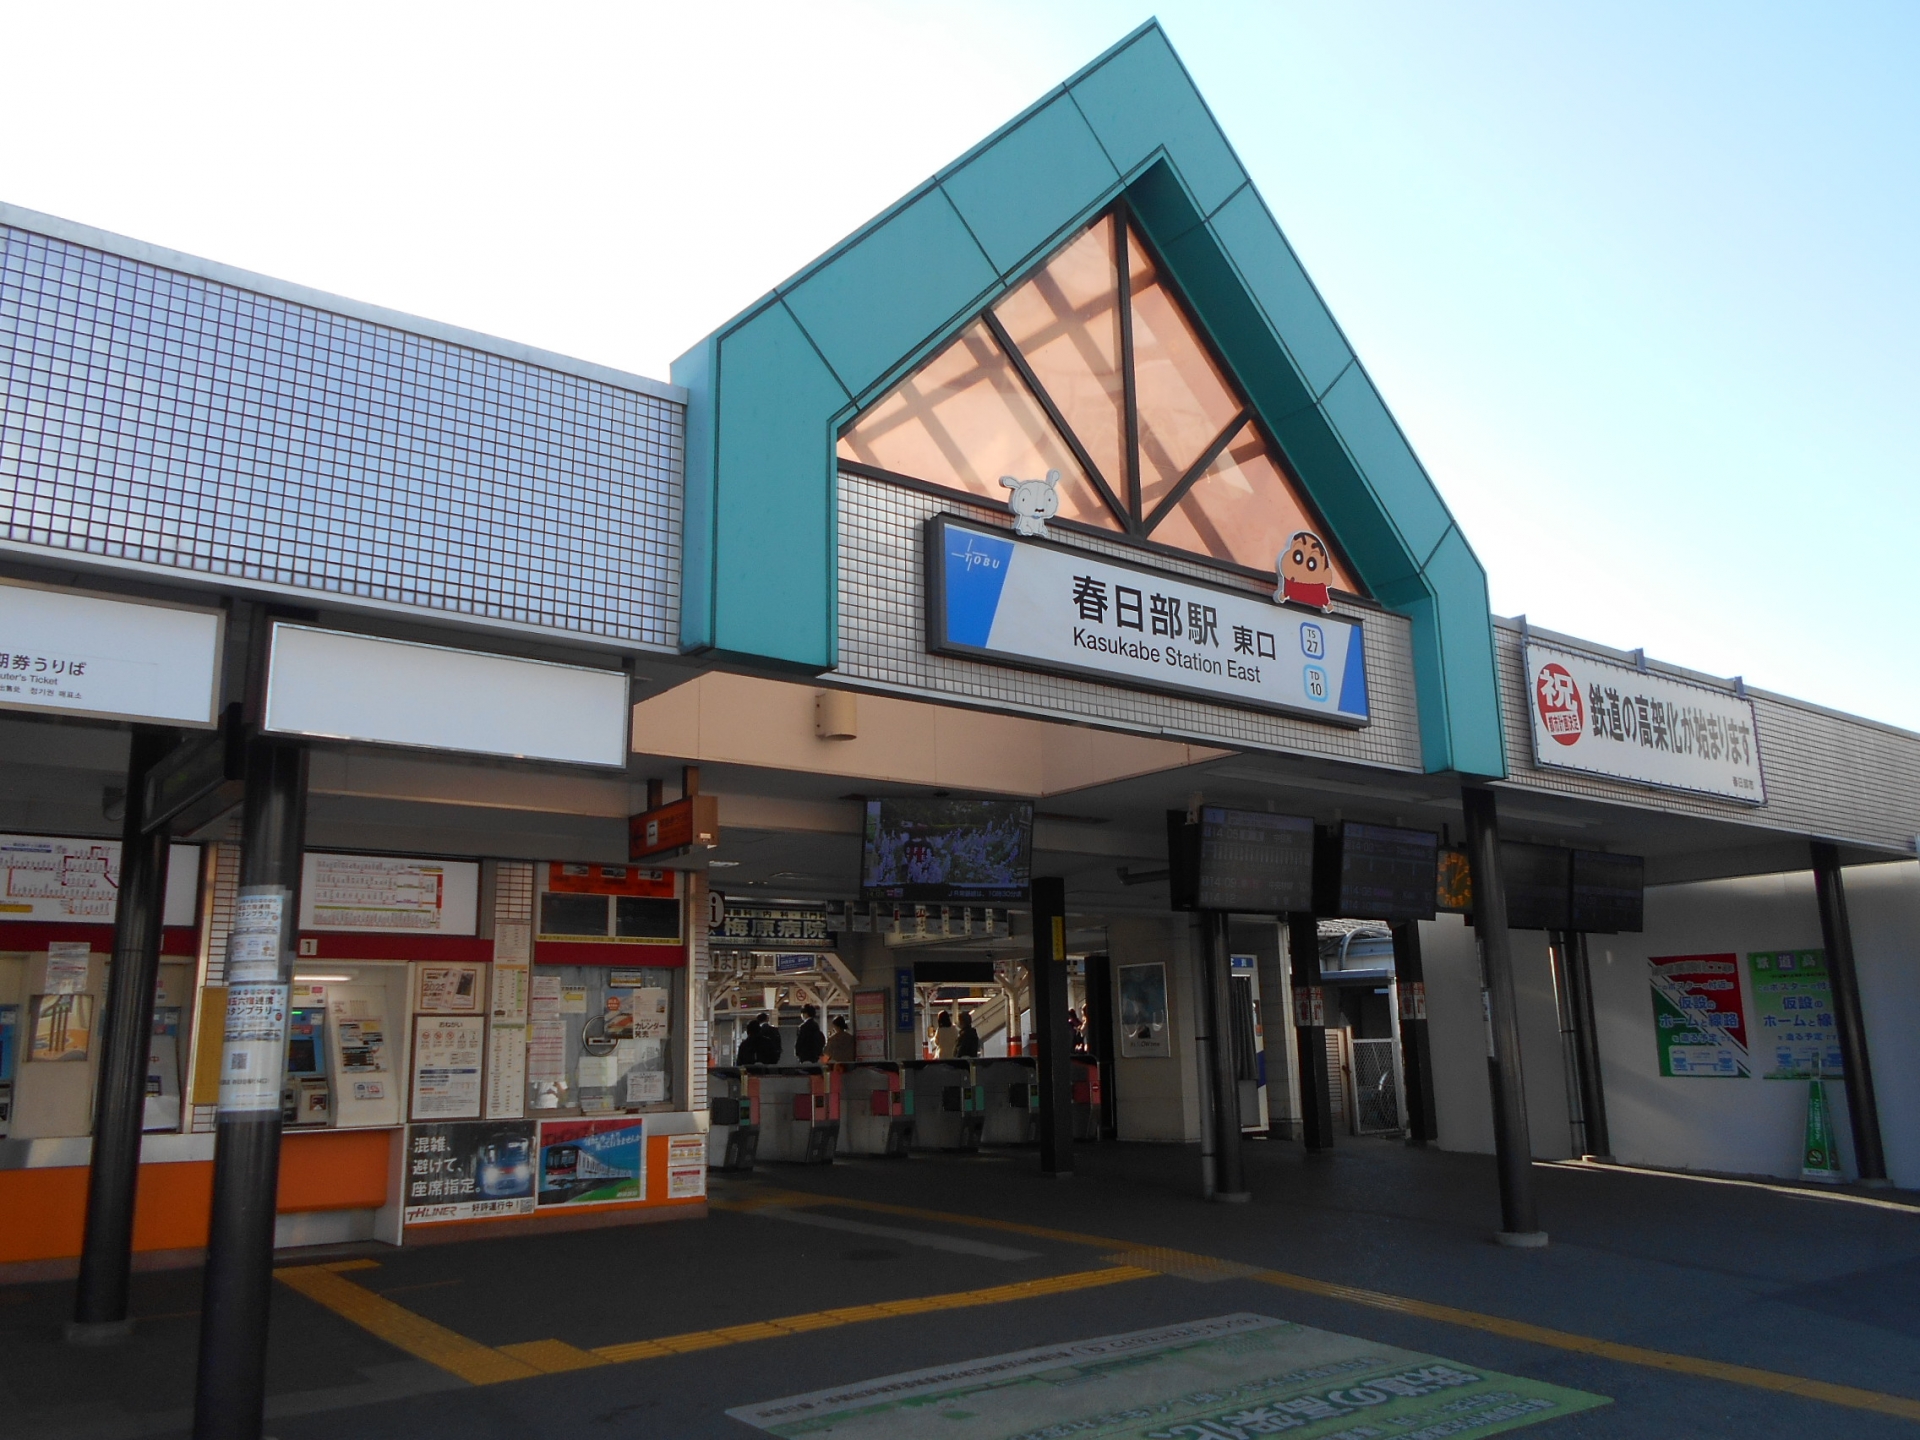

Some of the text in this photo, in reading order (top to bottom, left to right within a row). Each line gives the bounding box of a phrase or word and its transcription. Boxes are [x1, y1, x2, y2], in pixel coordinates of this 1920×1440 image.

[1072, 575, 1277, 661] 春日部駅 東口
[1307, 629, 1317, 639] TS
[1306, 639, 1319, 654] 27
[1072, 627, 1261, 684] Kasukabe Station East
[29, 675, 58, 686] Ticket
[1309, 670, 1320, 681] TD
[1310, 681, 1323, 697] 10
[1540, 670, 1578, 712] 祝
[1588, 682, 1752, 767] 鉄道の高架化が始まります
[724, 917, 827, 938] 梅原病院
[305, 941, 312, 953] 1
[1679, 995, 1717, 1010] 仮設の
[1783, 995, 1823, 1010] 仮設の
[634, 1022, 666, 1031] カレンダー
[1659, 1013, 1739, 1028] ホームと線路
[414, 1136, 453, 1153] 混雑、
[412, 1158, 464, 1176] 避けて、
[411, 1176, 482, 1198] 座席指定。
